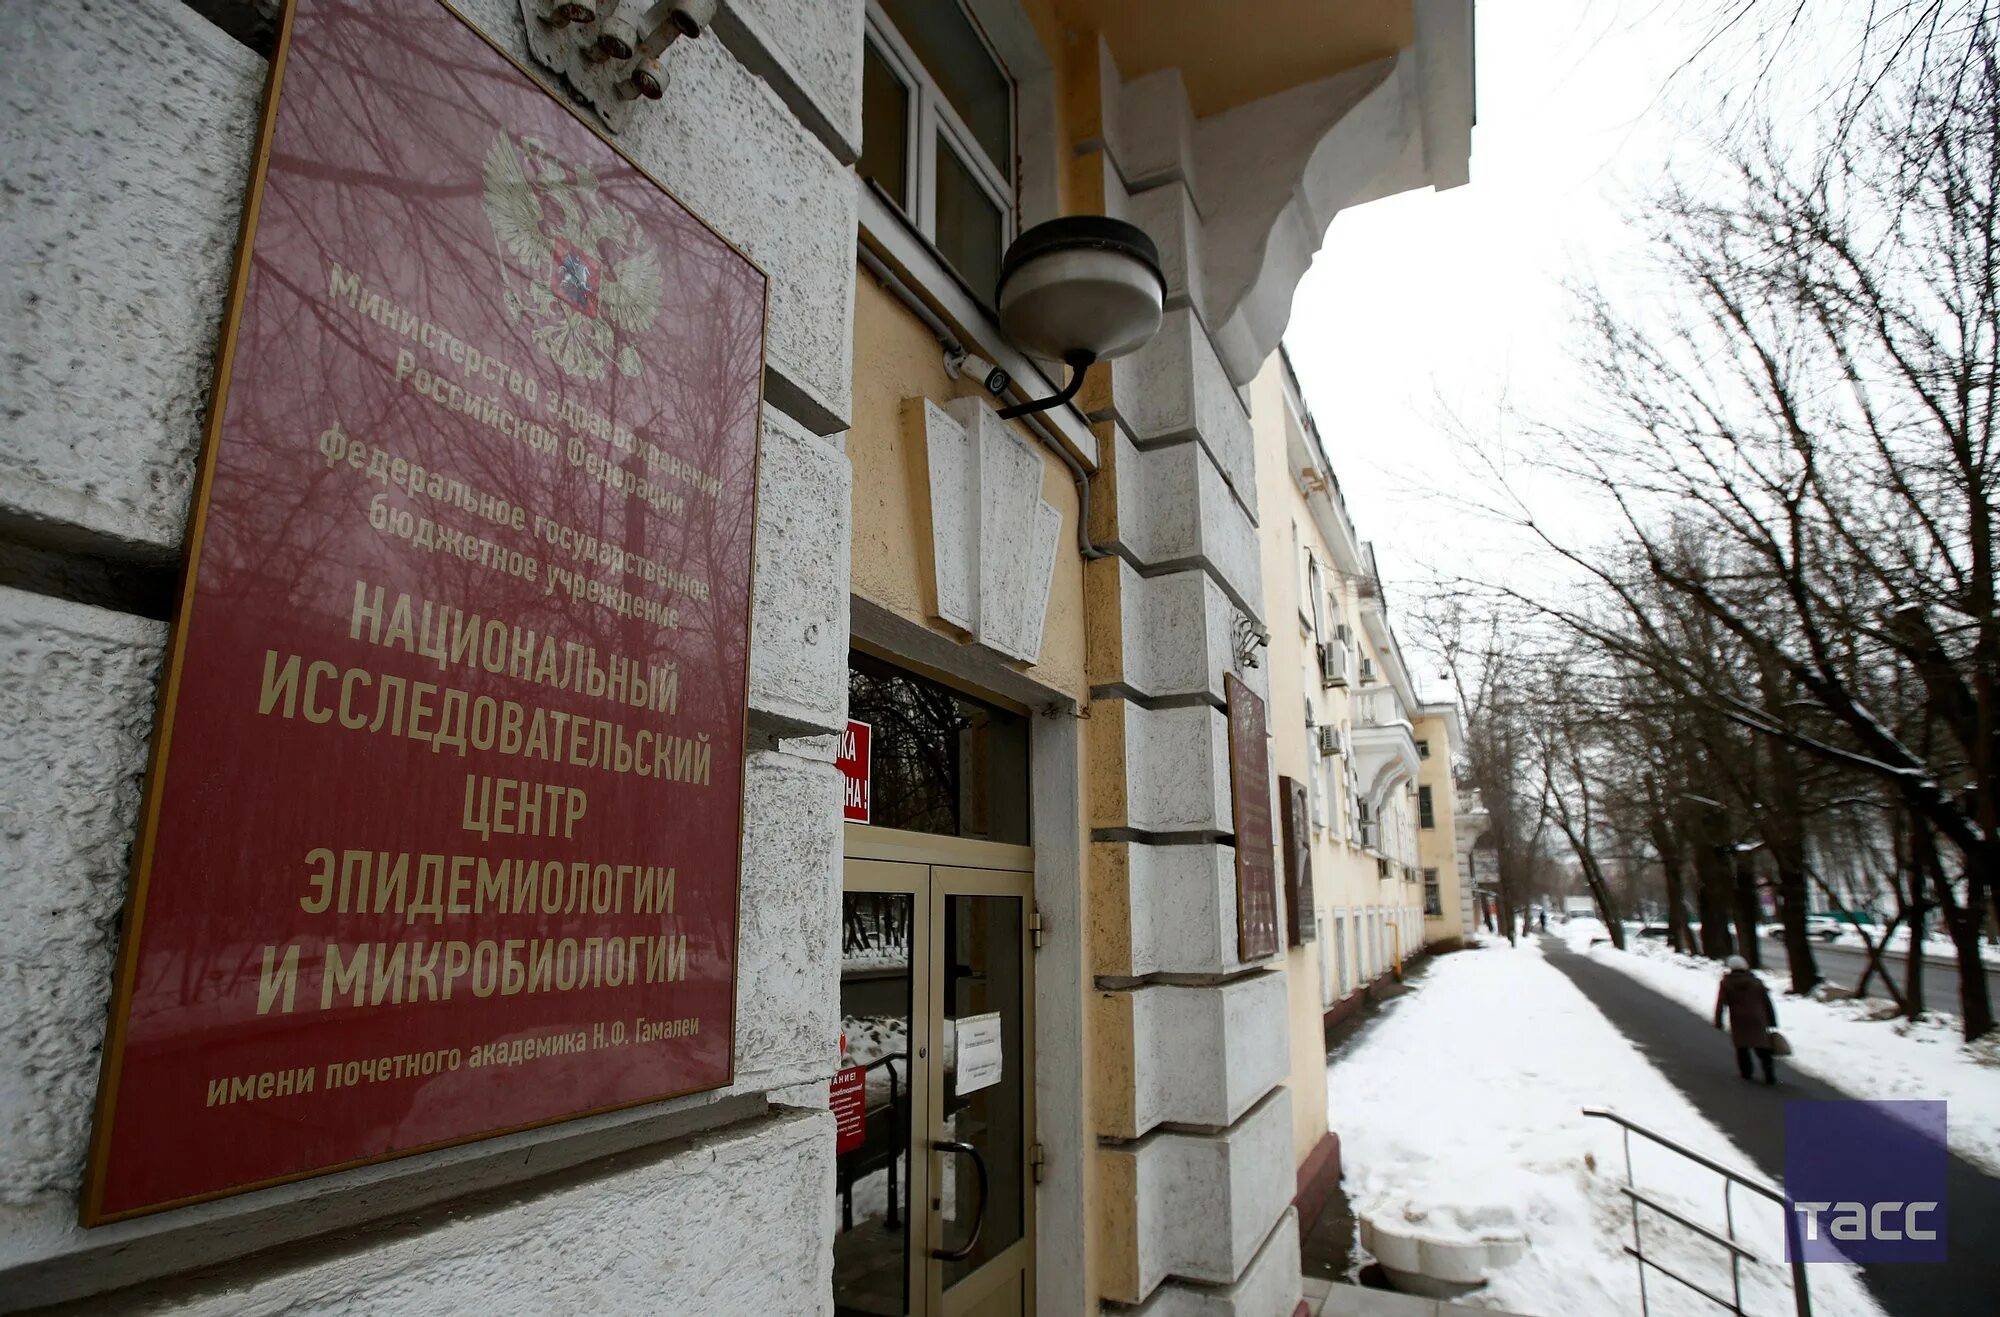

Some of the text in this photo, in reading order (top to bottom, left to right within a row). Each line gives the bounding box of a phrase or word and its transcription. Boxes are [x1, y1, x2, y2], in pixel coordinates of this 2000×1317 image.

[329, 262, 722, 499] Министерство здравоохранения
[396, 349, 685, 516] Российской Федерации
[318, 421, 710, 603] федеральное государственное
[369, 493, 679, 631] бюджетное учреждение
[348, 579, 679, 716] НАЦИОНАЛЬНЫЙ
[258, 649, 711, 786] ИССЛЕДОВАТЕЛЬСКИЙ
[462, 774, 587, 841] ЦЕНТР
[300, 847, 675, 925] ЭПИДЕМИОЛОГИИ
[256, 935, 687, 1016] И МИКРОБИОЛОГИИ
[206, 1017, 699, 1108] имени почетного академика Н.Ф. Гамалеи
